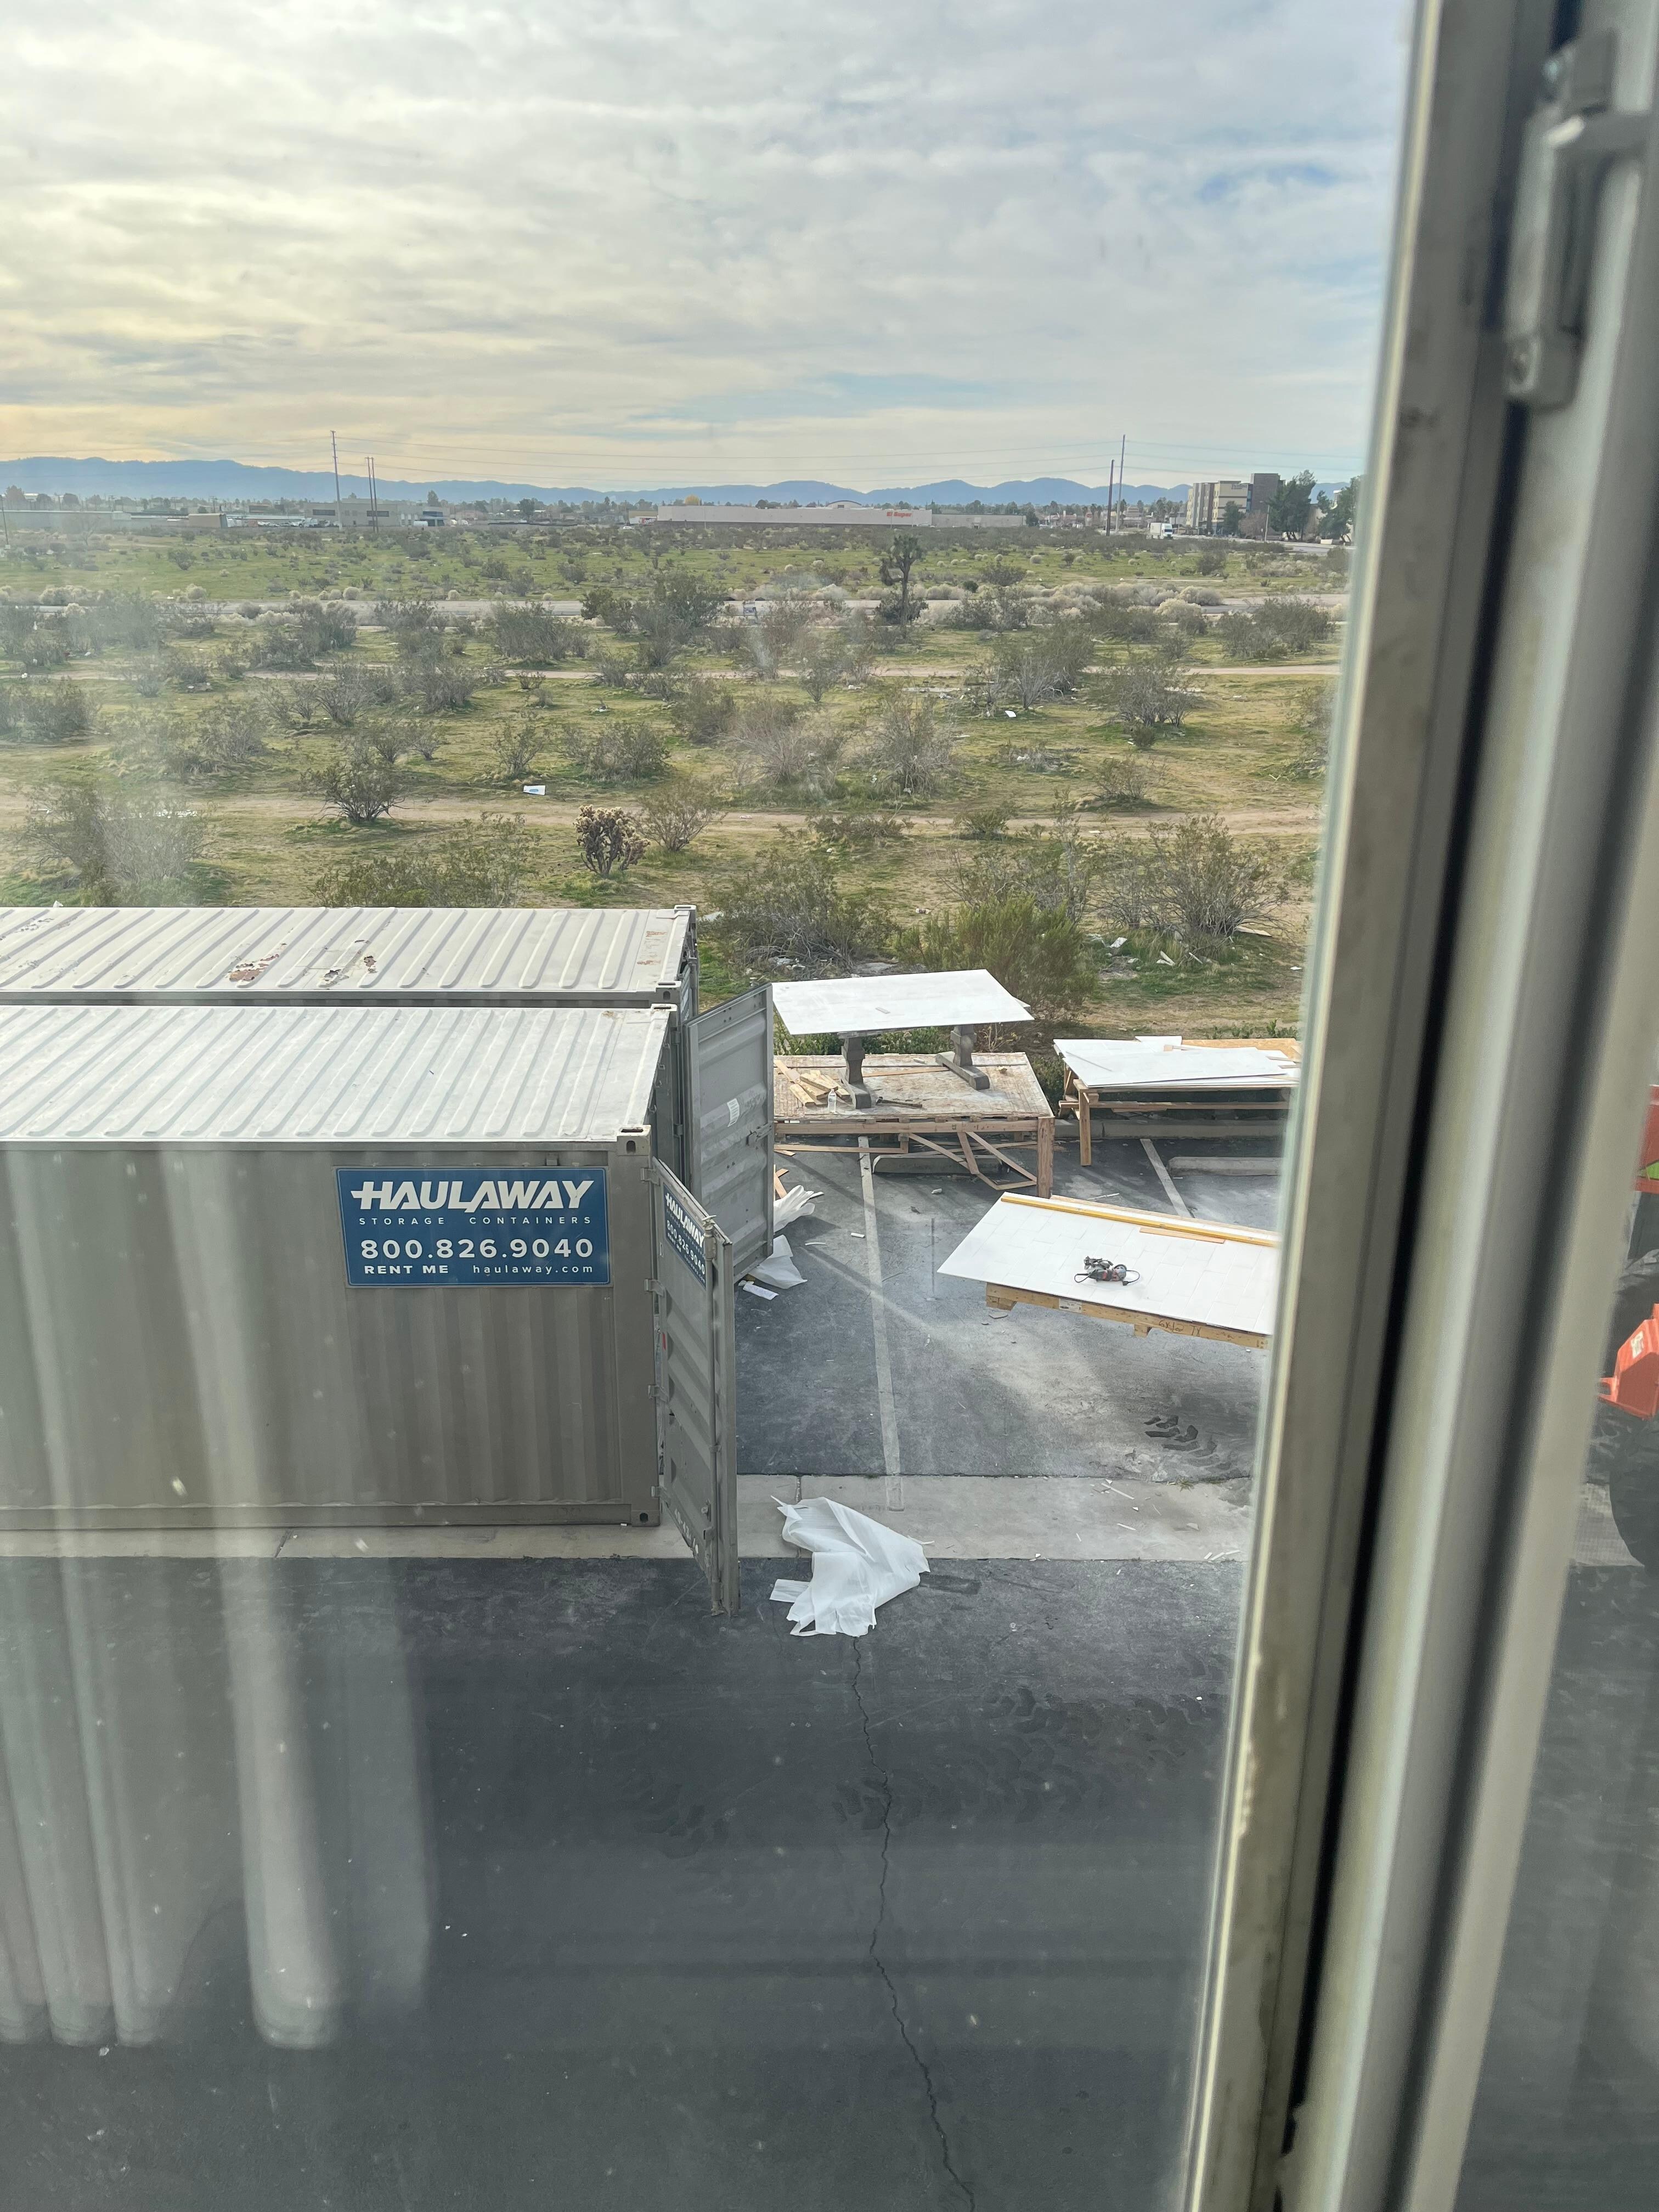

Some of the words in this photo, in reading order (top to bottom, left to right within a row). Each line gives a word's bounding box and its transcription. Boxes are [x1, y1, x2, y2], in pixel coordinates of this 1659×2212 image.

[351, 1180, 594, 1213] HAULAWAY
[665, 1193, 705, 1248] HAULAWAY
[361, 1238, 593, 1259] 800.826.9040
[364, 1265, 413, 1274] RENT
[422, 1265, 449, 1274] ME
[473, 1265, 593, 1275] haulaway.com
